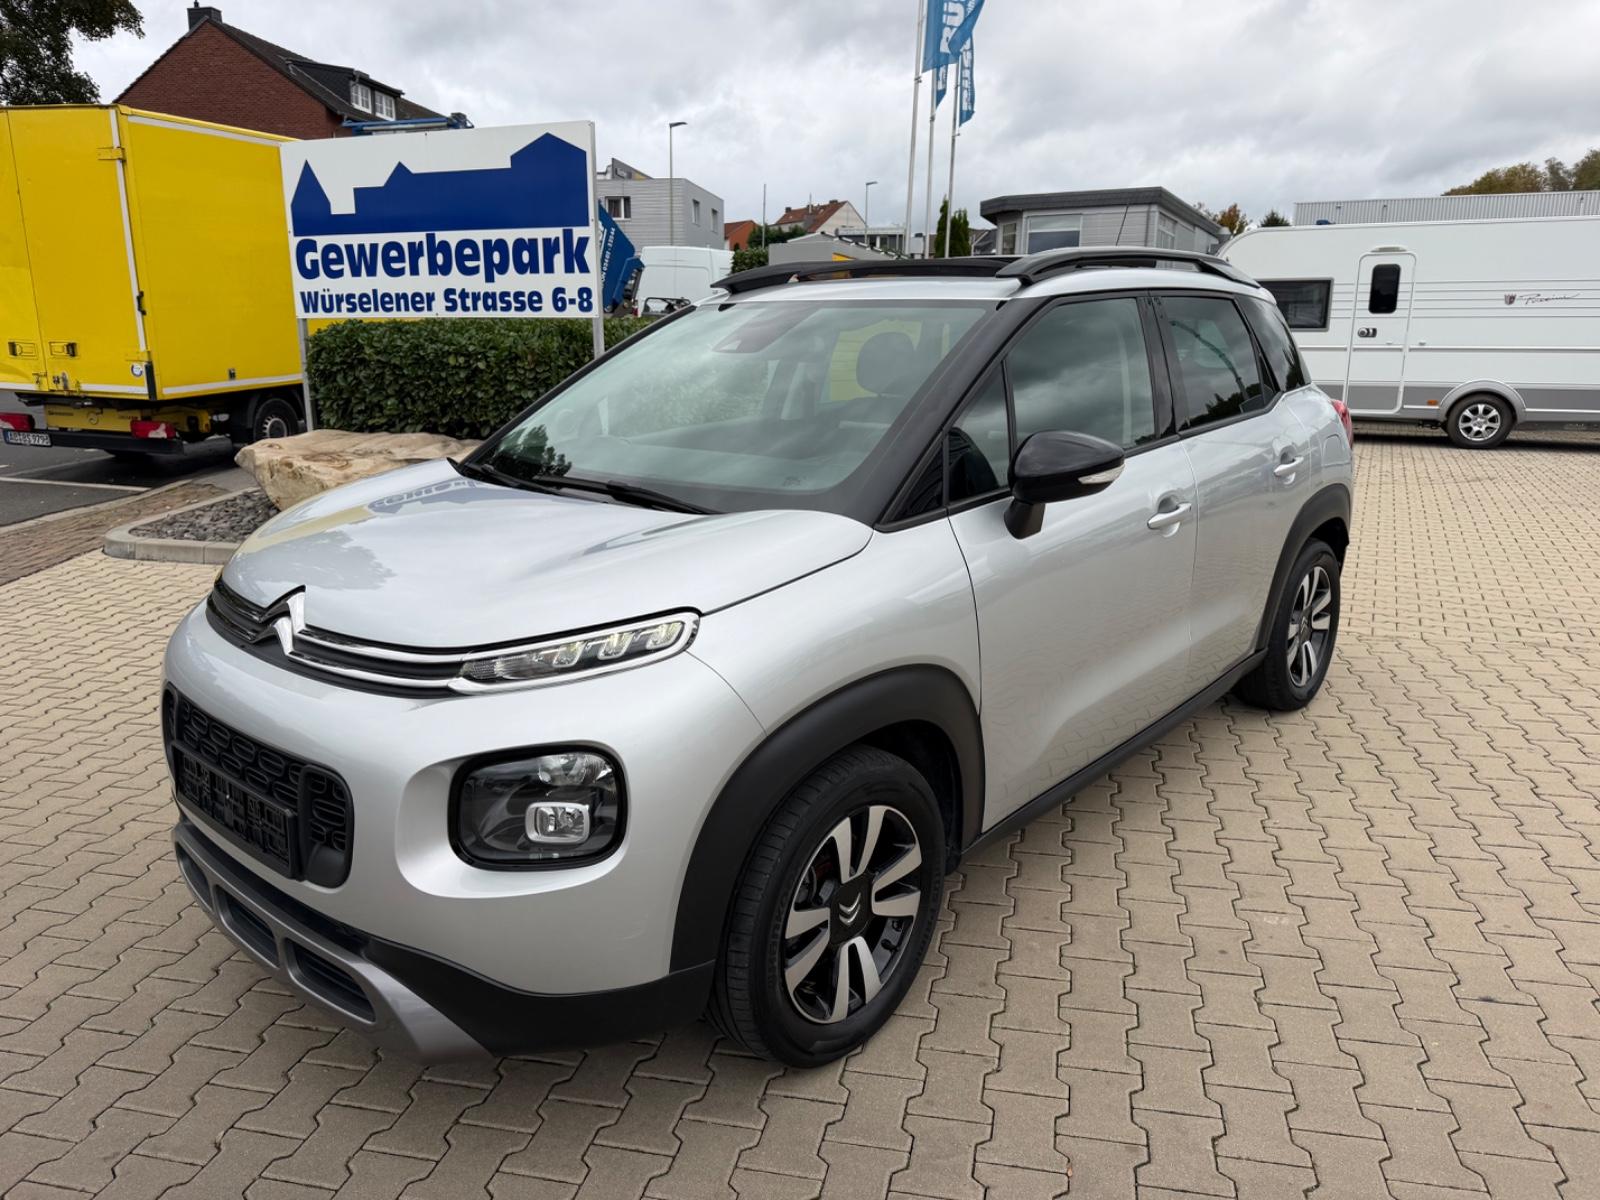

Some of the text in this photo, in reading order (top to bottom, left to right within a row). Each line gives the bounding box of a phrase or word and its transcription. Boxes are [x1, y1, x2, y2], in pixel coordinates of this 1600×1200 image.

[296, 229, 591, 283] Gewerbepark
[300, 287, 593, 314] Würselener Strasse 6-8
